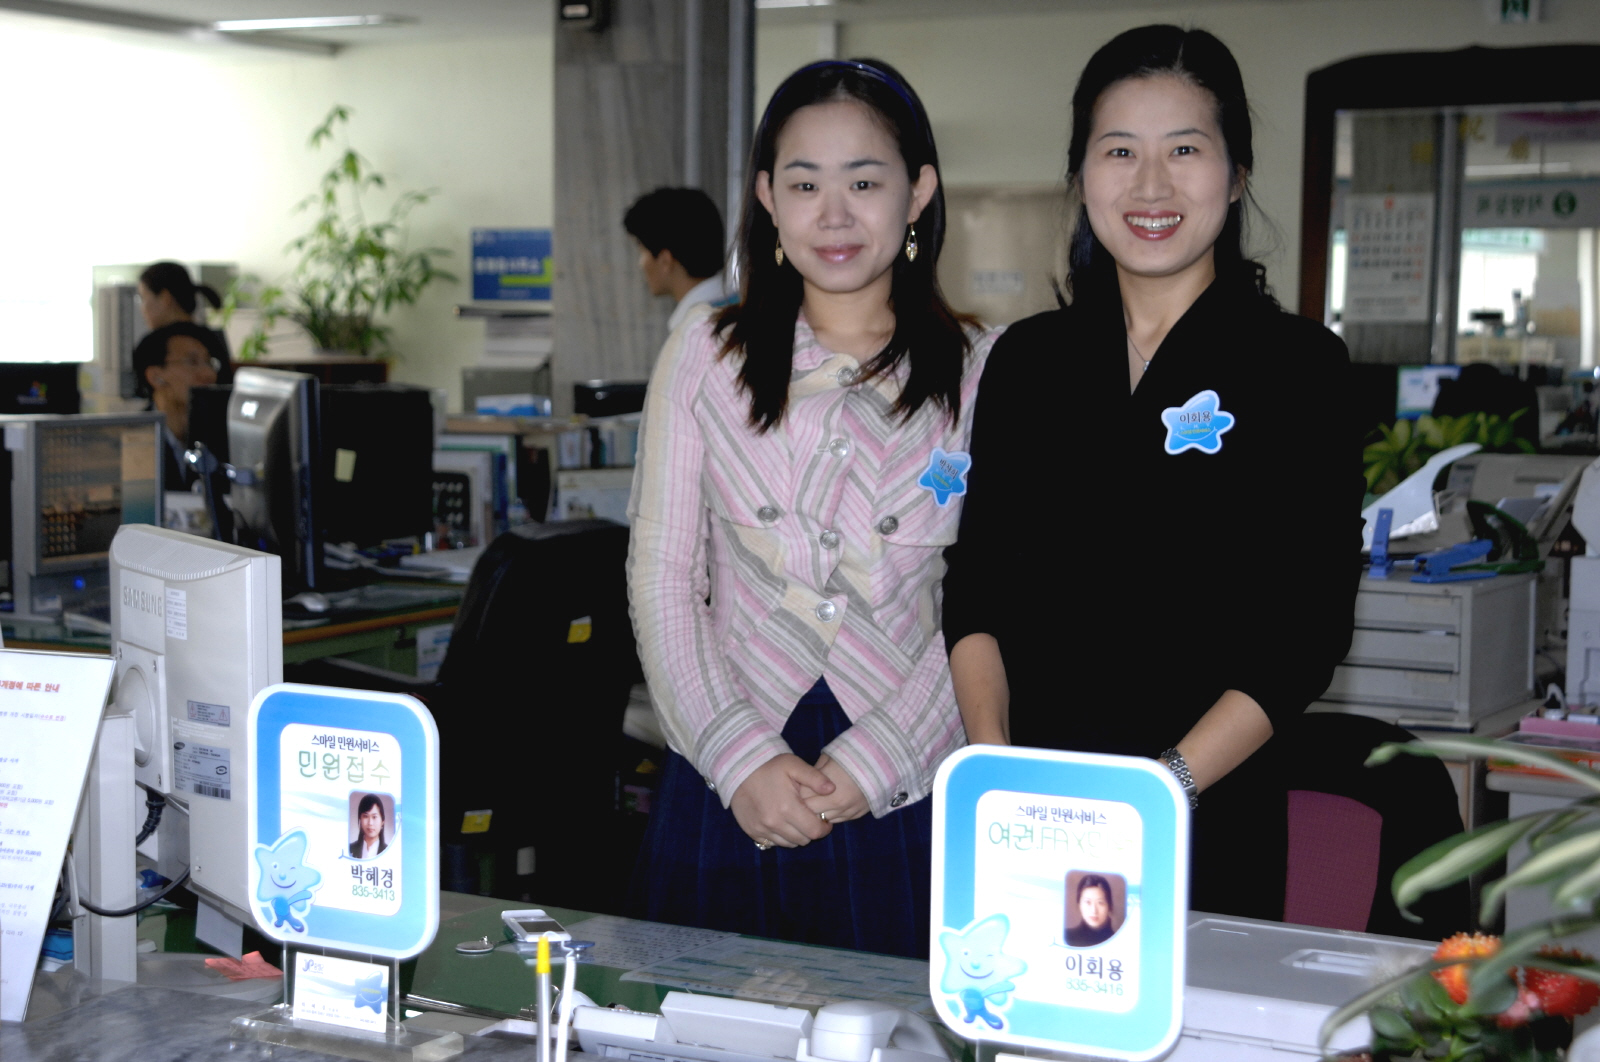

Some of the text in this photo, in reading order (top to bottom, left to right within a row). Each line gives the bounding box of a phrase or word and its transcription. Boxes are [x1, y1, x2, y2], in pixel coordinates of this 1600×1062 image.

[1179, 410, 1211, 424] 이회용
[123, 586, 163, 617] SAMSUNG
[26, 681, 42, 692] 따른
[44, 682, 61, 693] 안내
[311, 734, 380, 753] 스마일 민원서비스
[298, 750, 391, 786] 민원접수
[1015, 804, 1107, 826] 스마일 민원서비스
[351, 864, 393, 889] 박혜경
[352, 884, 395, 901] 835-3413
[1065, 953, 1124, 981] 이회용
[1066, 977, 1124, 996] 835-3416
